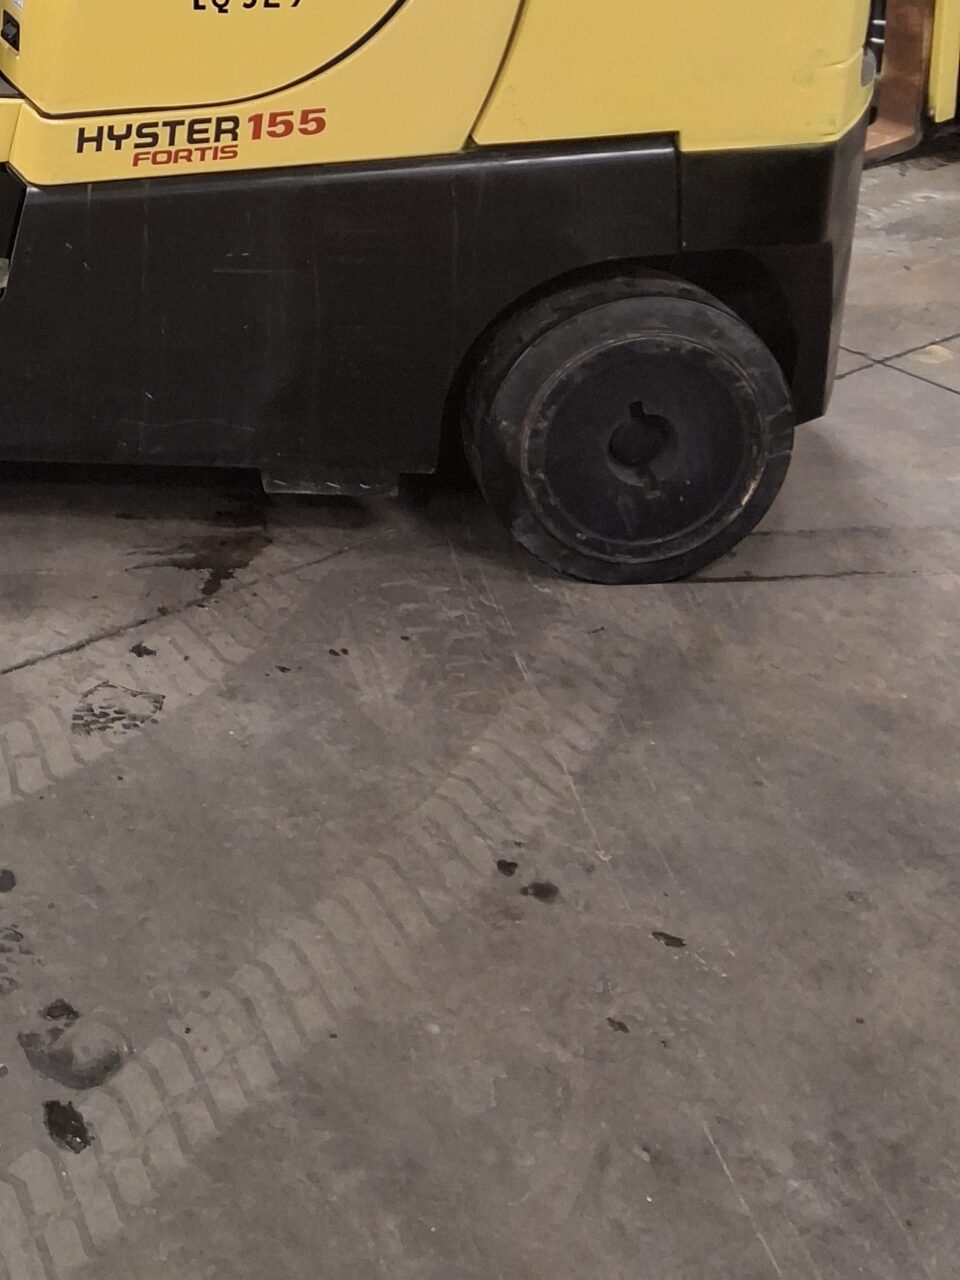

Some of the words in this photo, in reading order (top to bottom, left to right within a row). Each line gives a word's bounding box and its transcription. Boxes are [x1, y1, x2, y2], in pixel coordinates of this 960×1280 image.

[76, 115, 240, 154] HYSTER
[248, 108, 327, 141] 155
[132, 144, 239, 167] FORTIS
